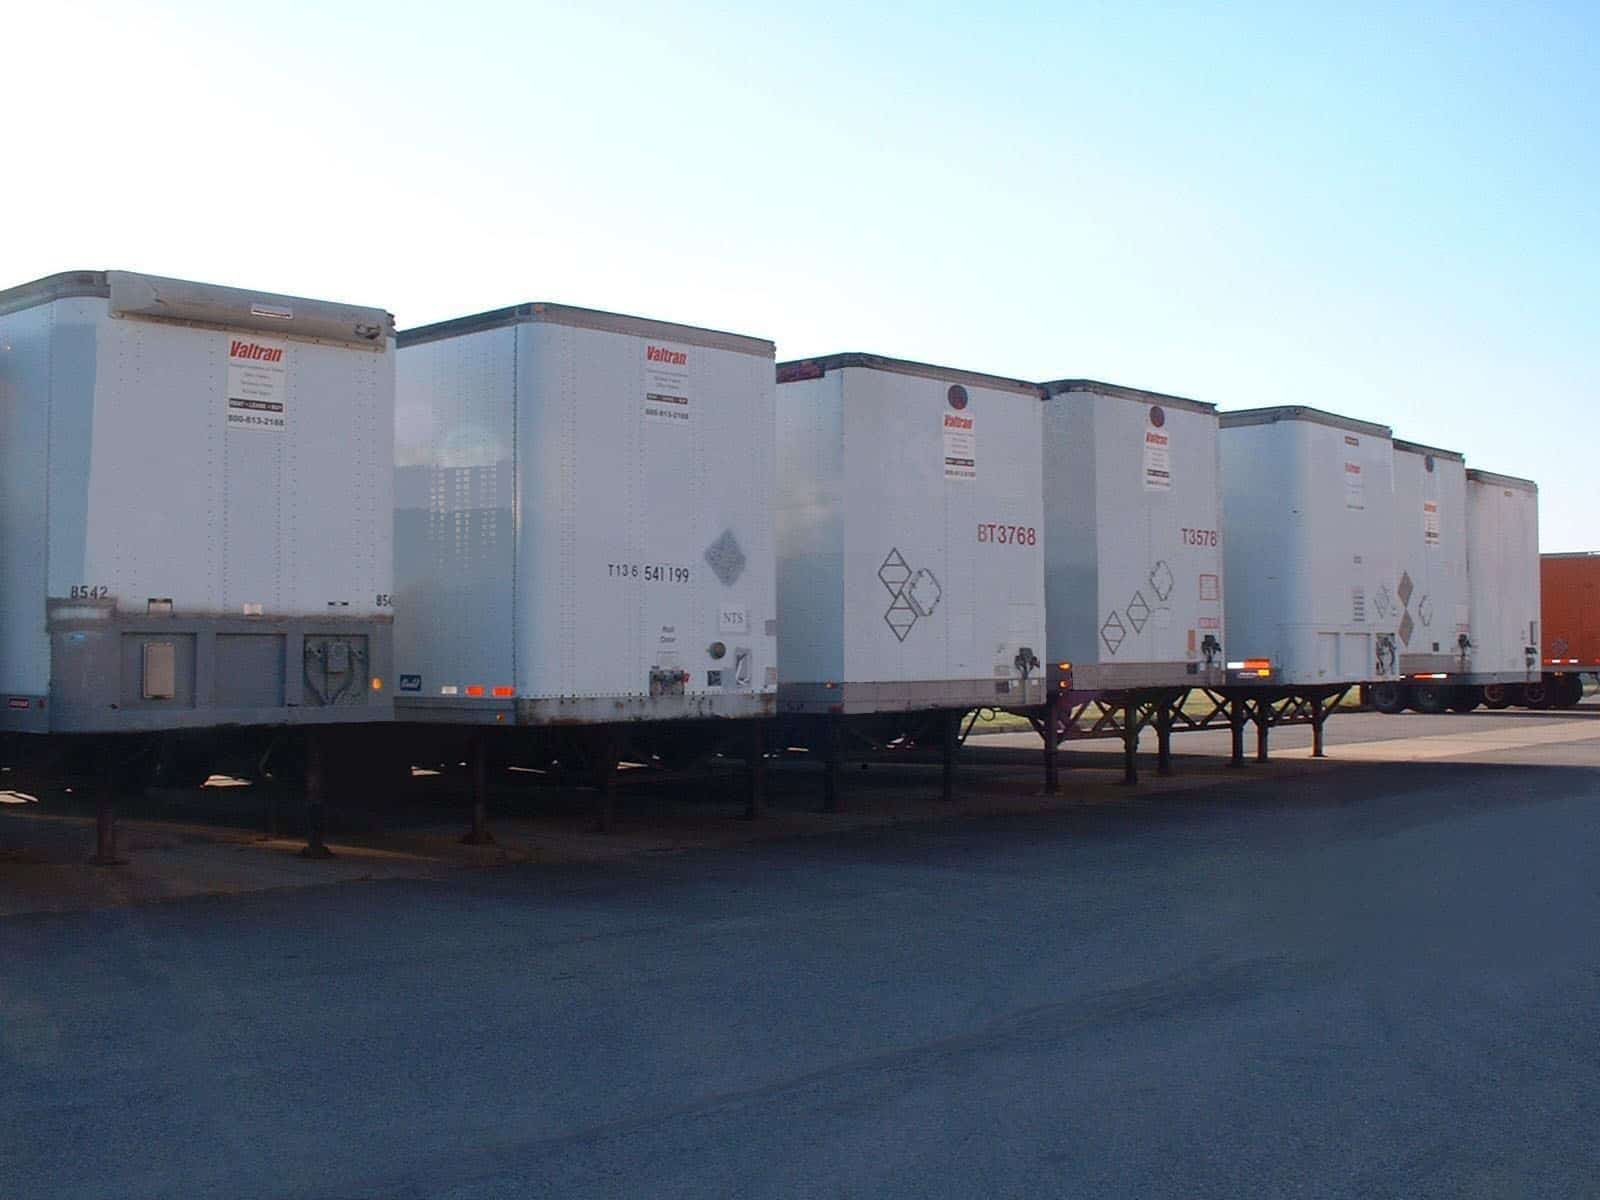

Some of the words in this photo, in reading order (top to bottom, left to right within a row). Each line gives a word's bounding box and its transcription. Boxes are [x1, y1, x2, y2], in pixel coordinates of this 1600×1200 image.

[230, 340, 283, 362] Valtran
[646, 345, 687, 366] Valtran
[977, 523, 1037, 546] BT3768
[71, 585, 109, 600] 8542
[723, 611, 745, 625] NTS
